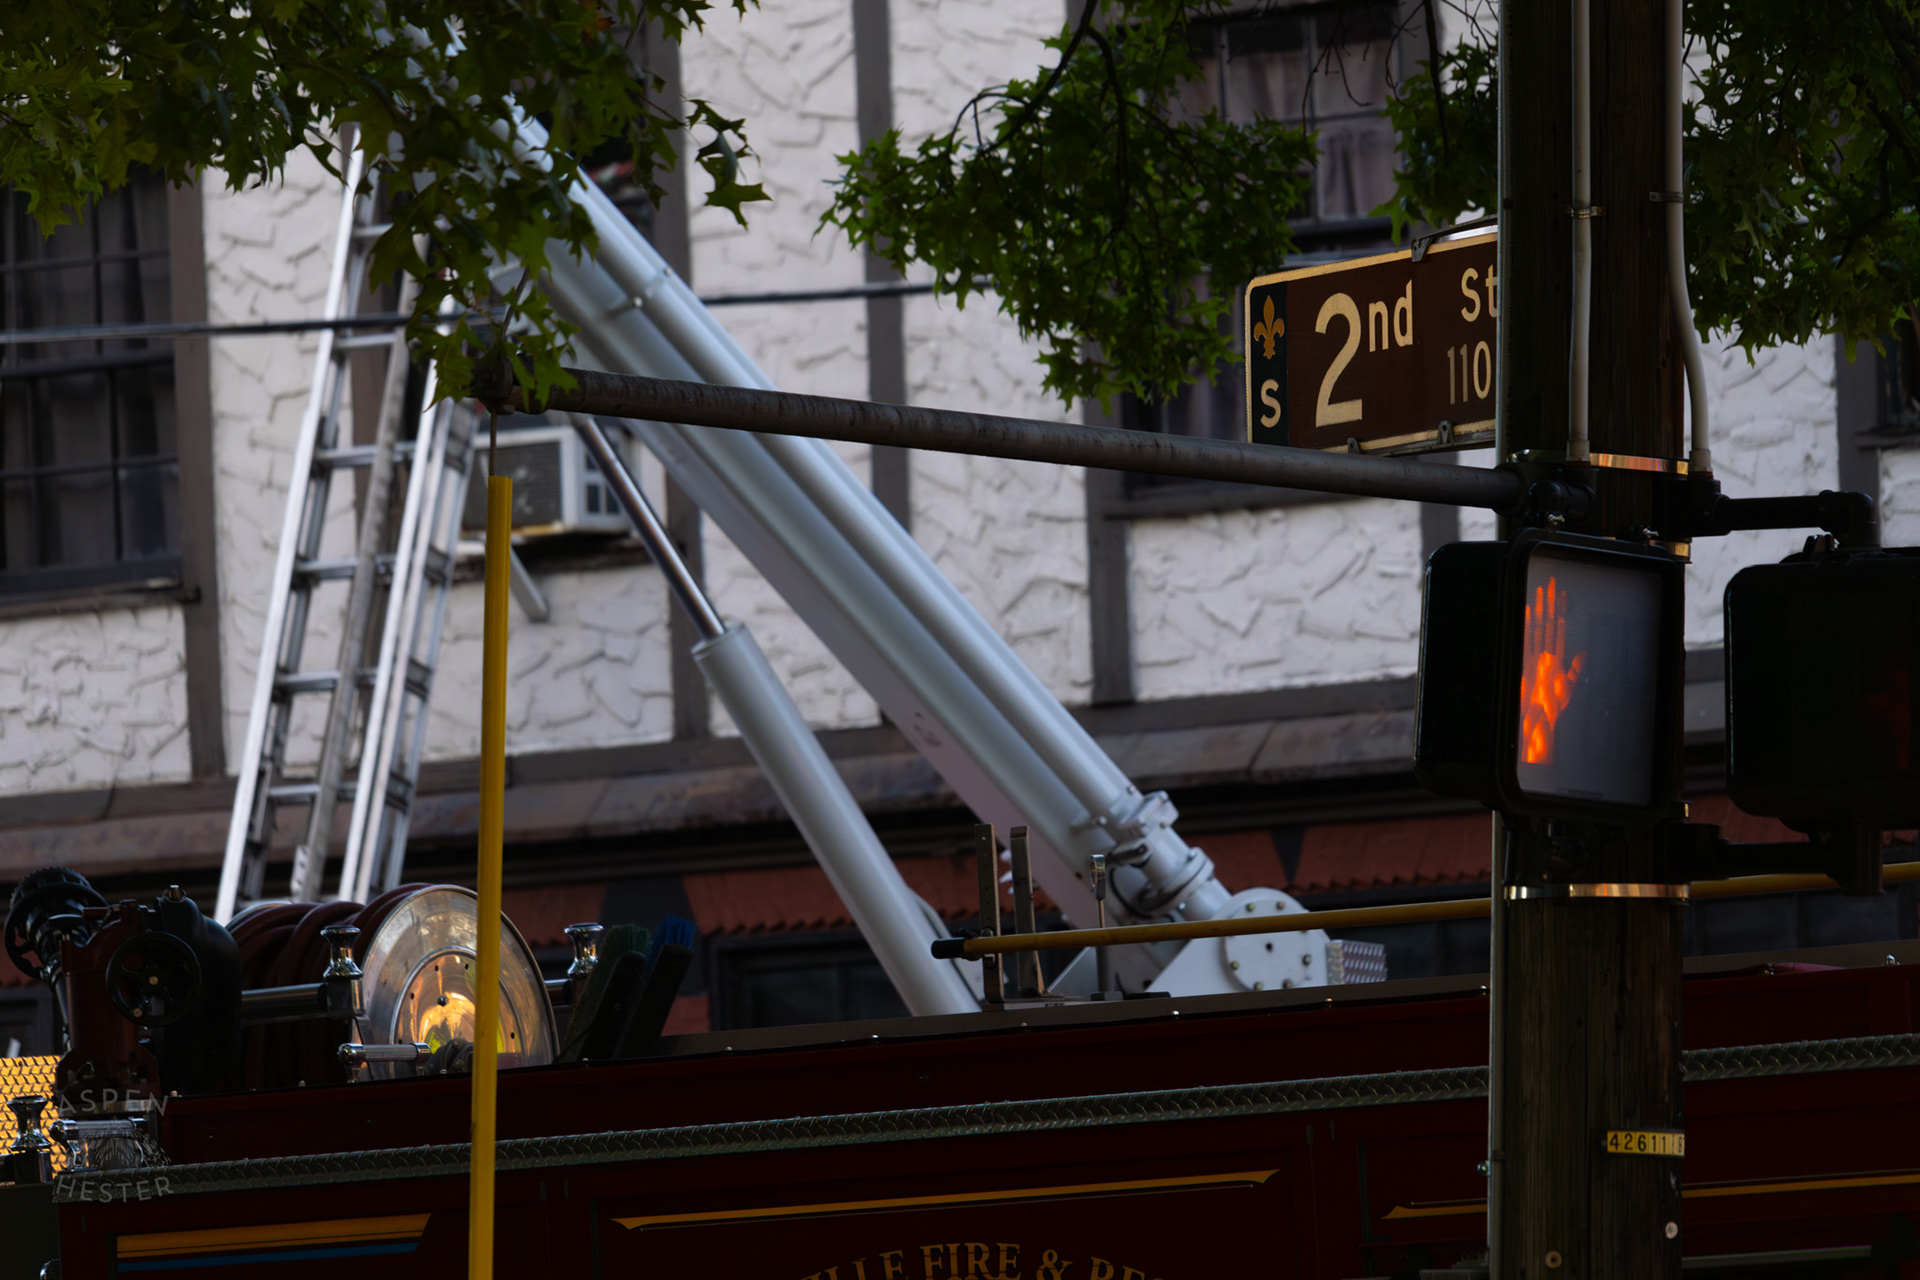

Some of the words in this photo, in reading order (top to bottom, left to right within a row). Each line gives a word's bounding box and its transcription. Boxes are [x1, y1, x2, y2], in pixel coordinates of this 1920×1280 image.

[1314, 279, 1414, 428] 2nd
[1460, 264, 1498, 322] St
[1447, 340, 1492, 405] 110
[1260, 378, 1282, 428] S
[919, 1241, 1022, 1280] FIRE
[1036, 1248, 1073, 1280] &
